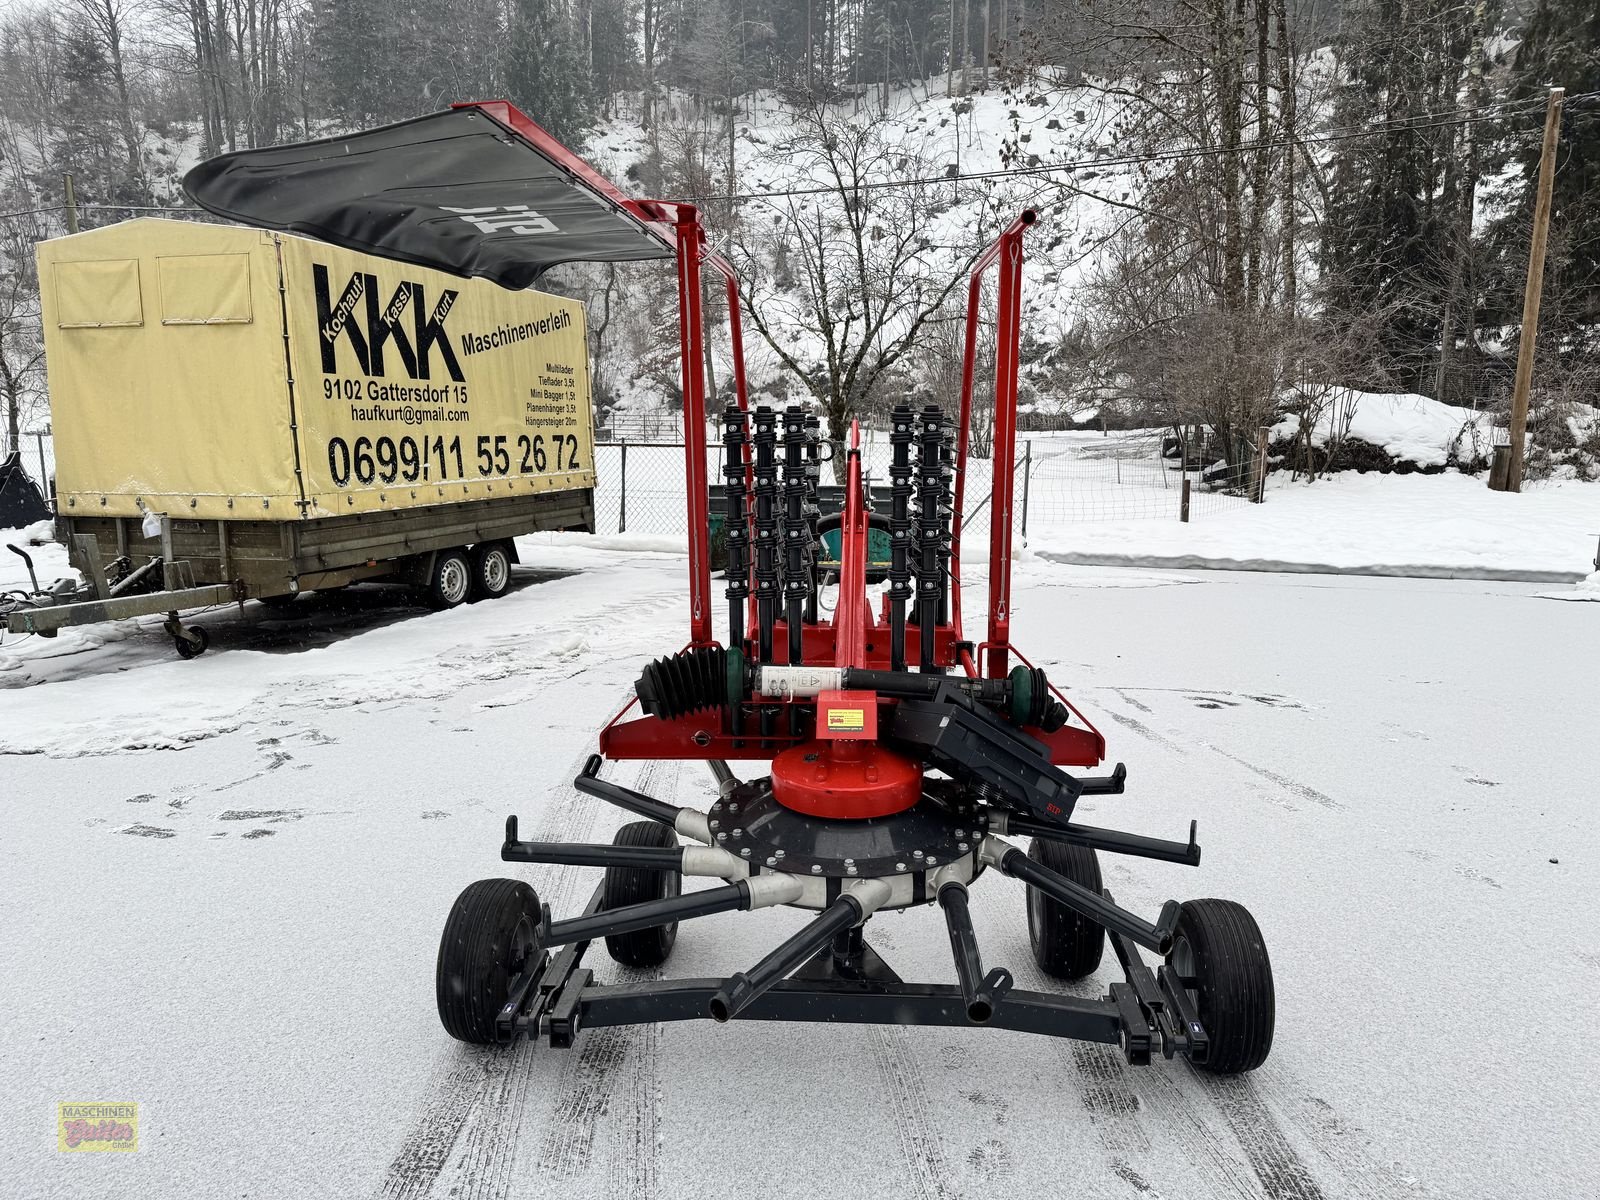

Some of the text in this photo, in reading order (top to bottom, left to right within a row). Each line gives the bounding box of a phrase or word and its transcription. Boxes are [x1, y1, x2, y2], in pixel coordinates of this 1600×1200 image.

[322, 275, 364, 343] Kochauf
[383, 284, 411, 329] Kassl
[433, 292, 454, 326] Kurt
[313, 263, 466, 382] KKK
[461, 309, 571, 356] Maschinenverleih
[546, 363, 574, 375] Multilader
[323, 378, 468, 404] 9102 Gattersdorf 15
[538, 376, 575, 388] Tieflader 3,5t
[530, 389, 576, 402] Mini Bagger 1,5t
[351, 404, 470, 425] haufkurt@gmail.com
[526, 403, 577, 415] Planenhänger 3,5t
[525, 416, 577, 428] Hängersteiger 20m
[328, 434, 580, 487] 0699/11 55 26 72
[1046, 803, 1062, 815] SIP
